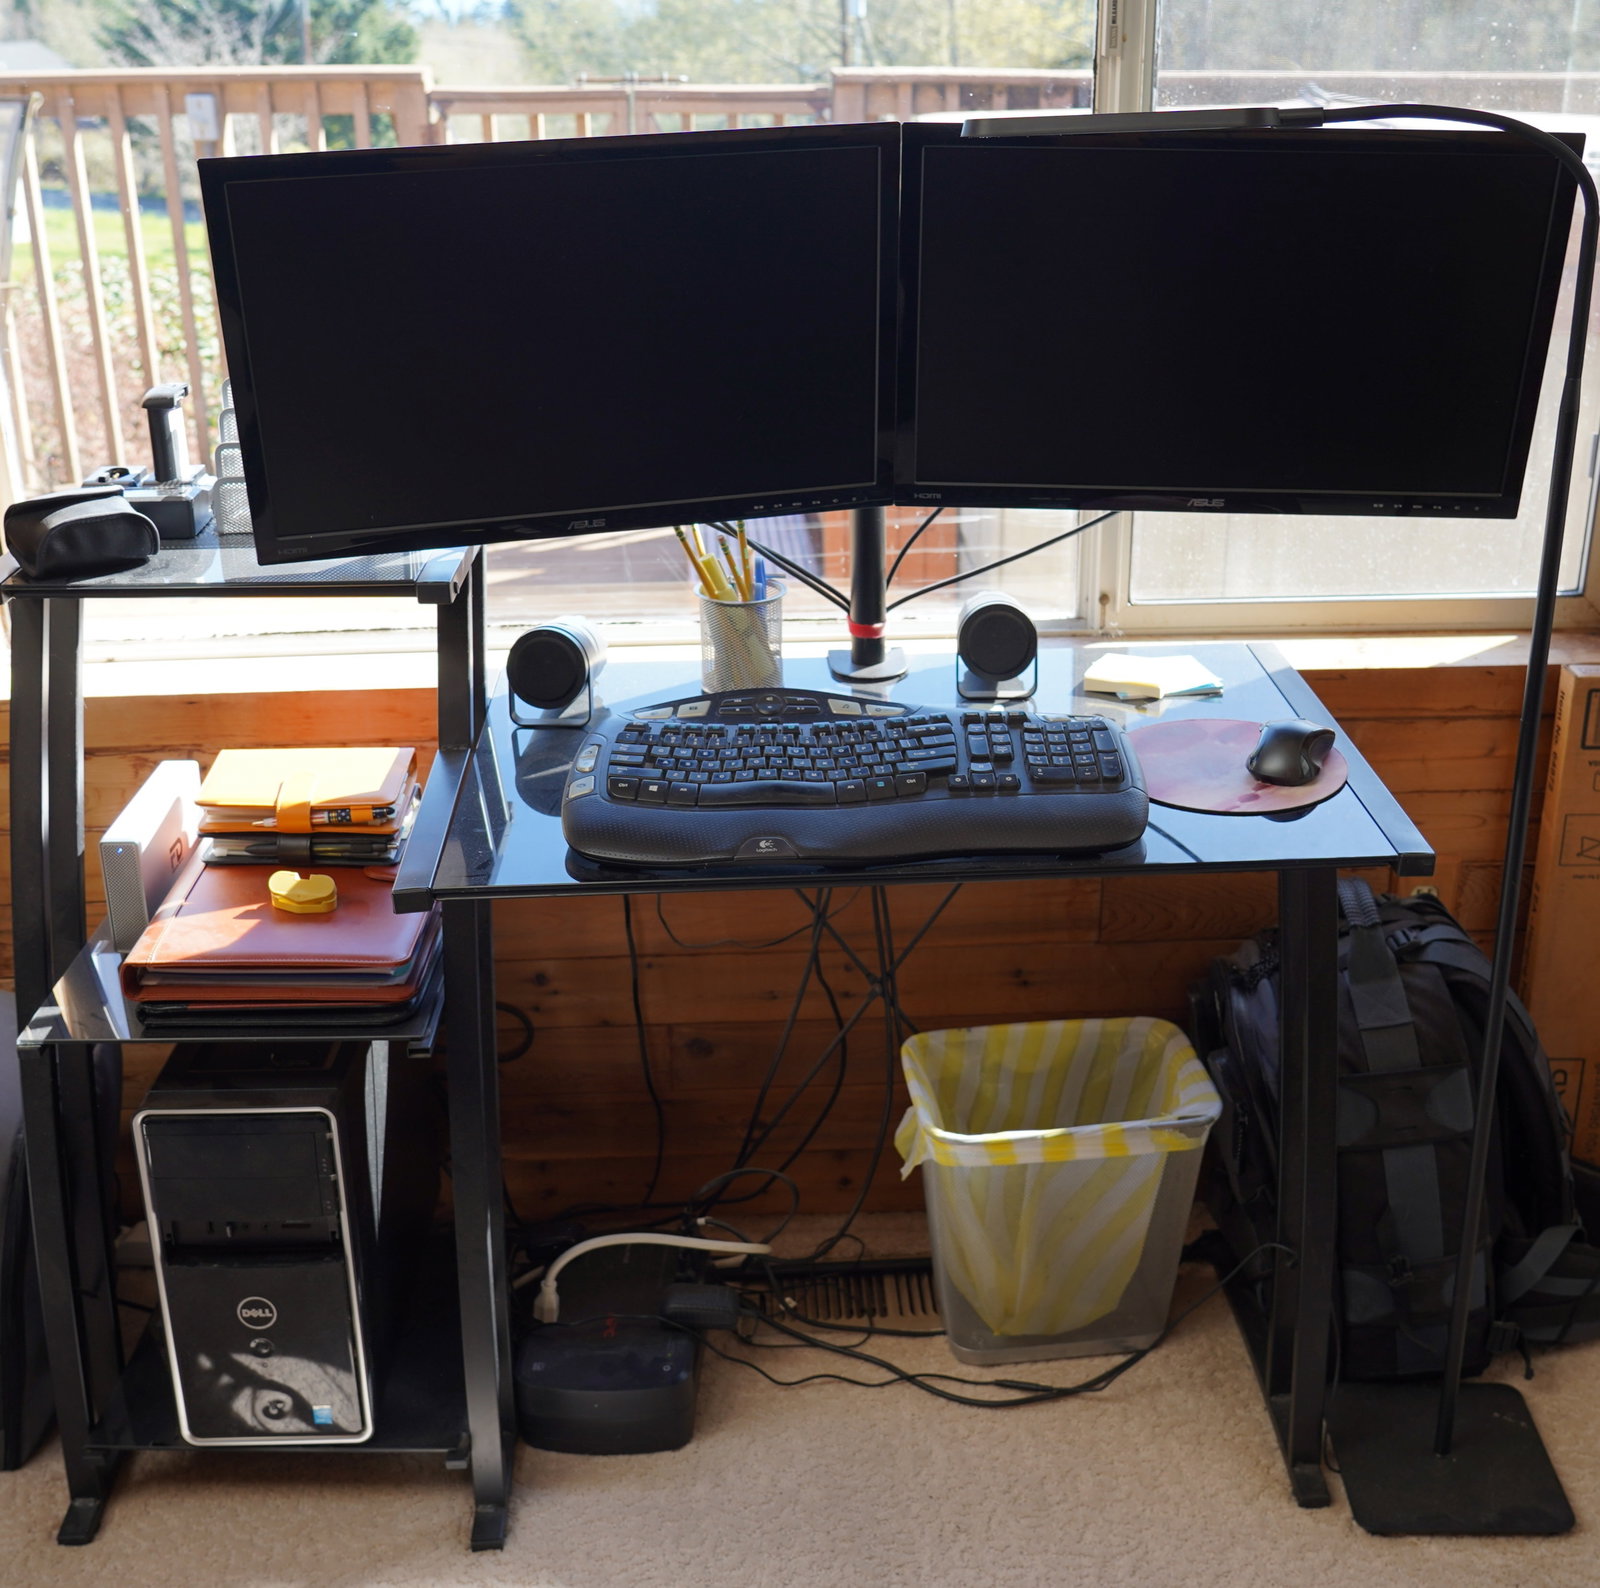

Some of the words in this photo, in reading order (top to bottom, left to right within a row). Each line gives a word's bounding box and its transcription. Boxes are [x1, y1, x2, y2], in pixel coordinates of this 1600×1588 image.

[1187, 498, 1225, 507] ASUS
[567, 518, 606, 530] ASUS
[241, 1308, 273, 1318] DELL
